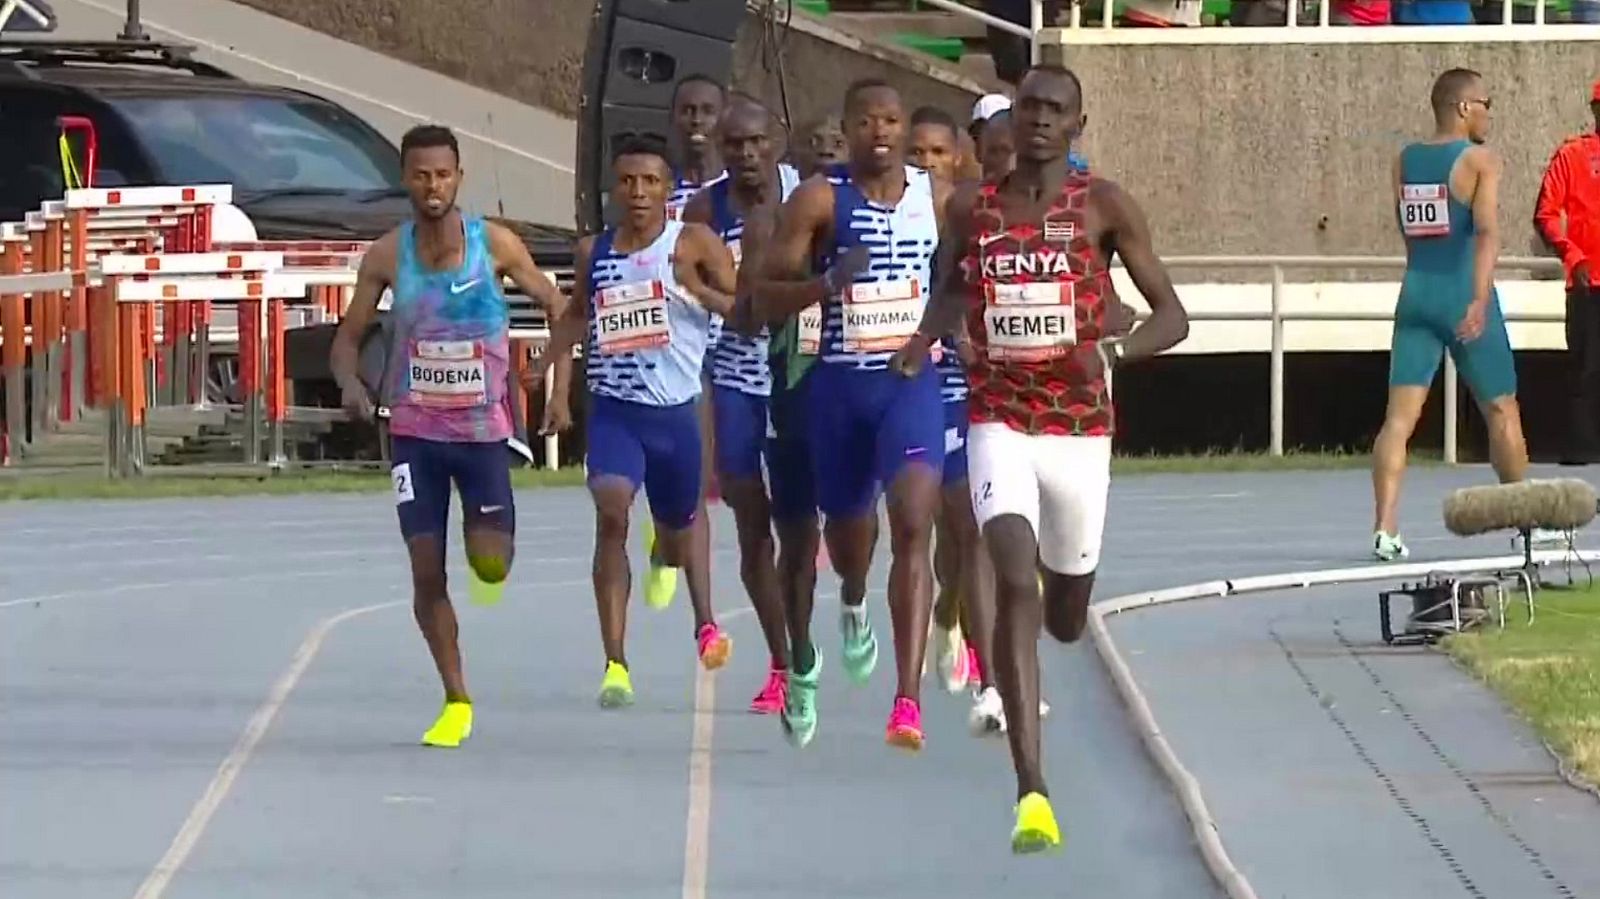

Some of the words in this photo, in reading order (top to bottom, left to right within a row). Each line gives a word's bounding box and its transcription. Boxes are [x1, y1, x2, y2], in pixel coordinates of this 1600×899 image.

[1406, 203, 1436, 223] 810
[983, 252, 1071, 277] KENYA
[599, 307, 664, 333] TSHITE
[847, 311, 918, 326] KINYAMAL
[993, 315, 1065, 336] KEMEI
[412, 366, 482, 384] BODENA
[397, 476, 407, 493] 2
